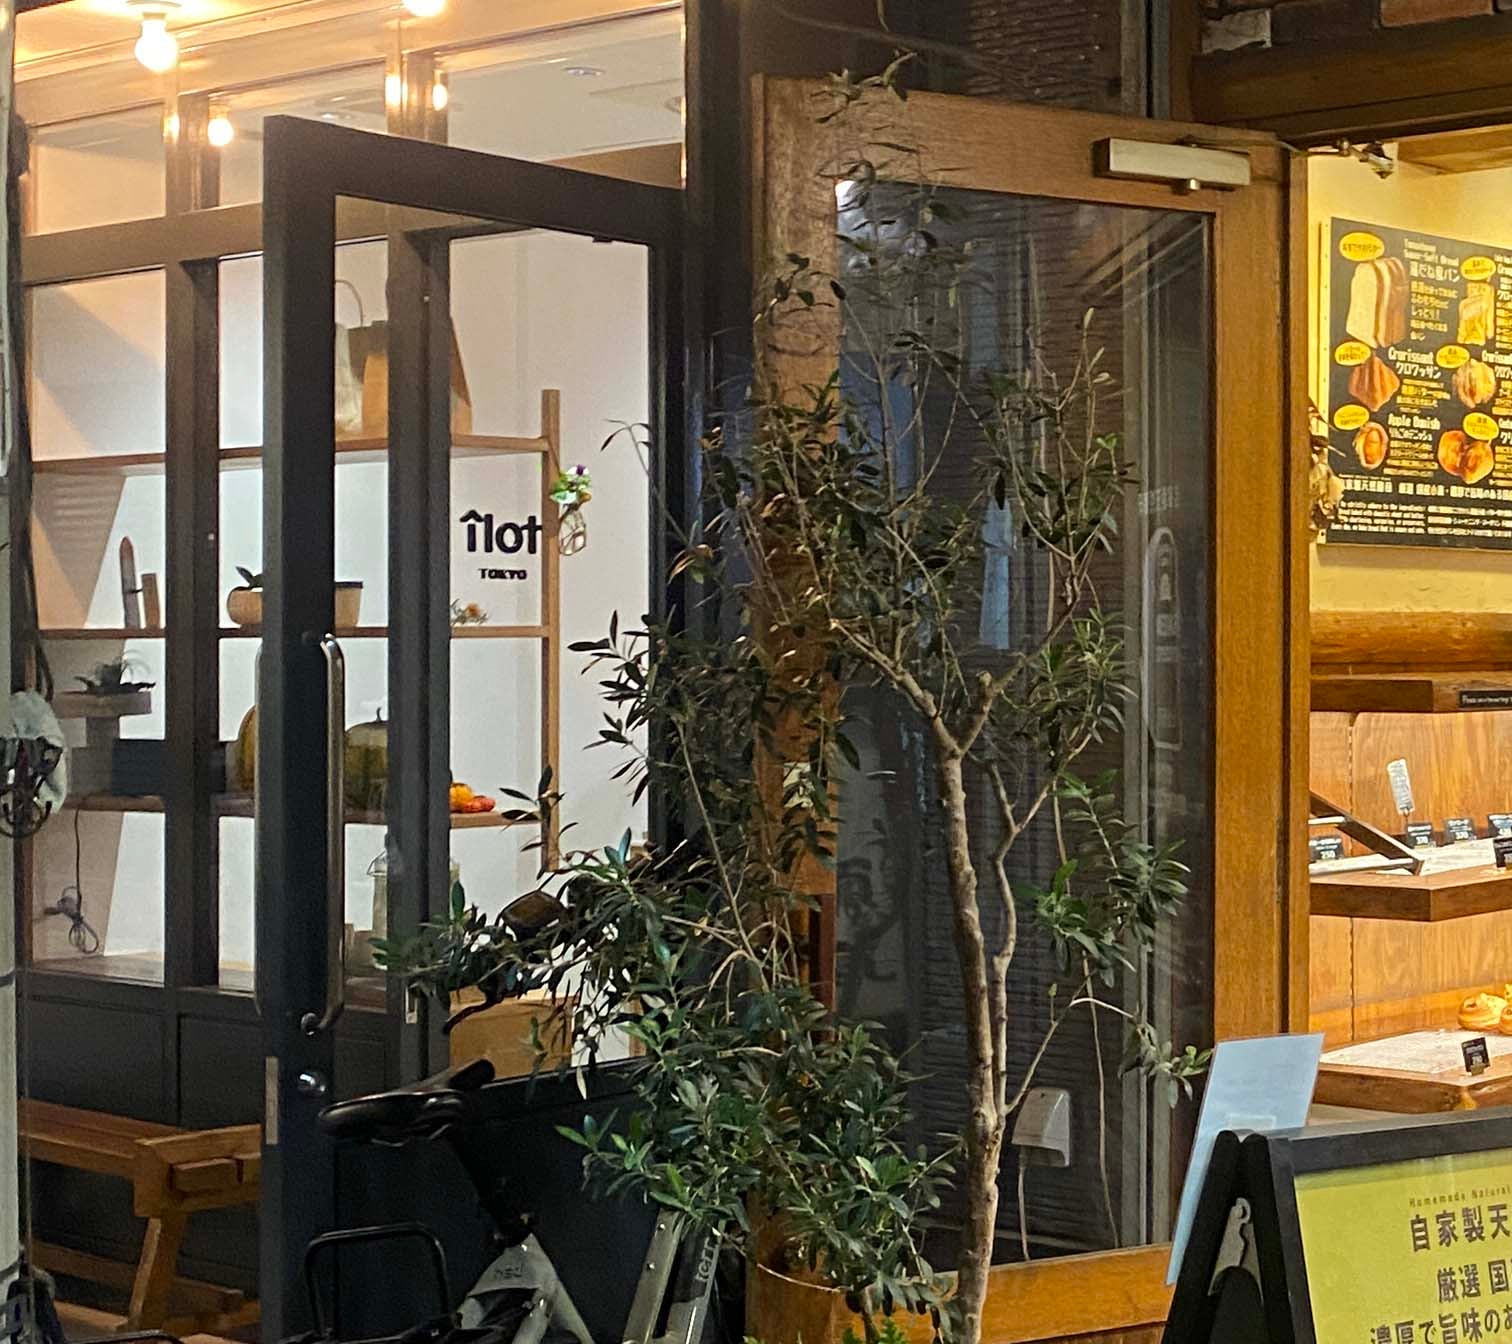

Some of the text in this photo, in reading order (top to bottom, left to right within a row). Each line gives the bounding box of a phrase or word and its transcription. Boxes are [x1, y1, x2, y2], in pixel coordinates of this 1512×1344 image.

[459, 509, 543, 555] îlot
[478, 567, 528, 581] TOKYO
[1436, 1263, 1481, 1304] 厳選
